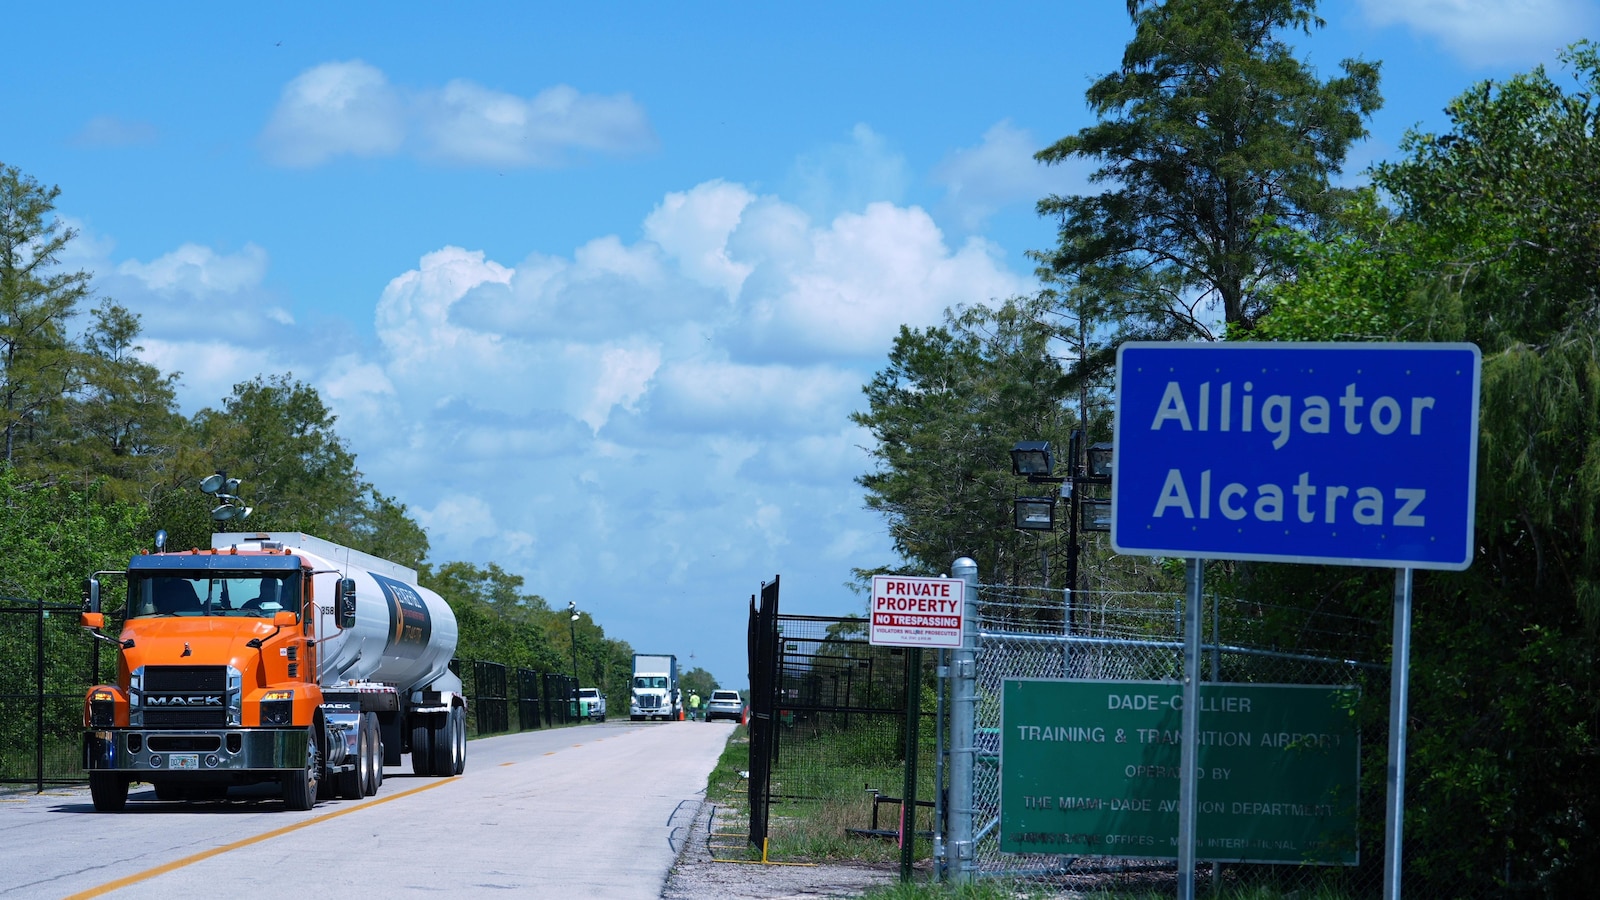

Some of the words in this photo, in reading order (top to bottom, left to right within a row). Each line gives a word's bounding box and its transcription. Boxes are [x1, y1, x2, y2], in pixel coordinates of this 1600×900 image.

[1150, 381, 1436, 450] Alligator
[1152, 469, 1427, 527] Alcatraz
[886, 581, 950, 597] PRIVATE
[877, 597, 958, 613] PROPERTY
[876, 615, 890, 624] NO
[892, 615, 958, 627] TRESPASSING
[146, 695, 222, 706] MACK
[1108, 694, 1251, 712] DADE-CLLIER
[1017, 725, 1105, 743] TRAINING
[1114, 728, 1127, 744] &
[1136, 728, 1251, 746] TRANITION
[1212, 768, 1231, 780] BY
[1024, 796, 1051, 810] THE
[1059, 797, 1151, 812] MIAMI-DADE
[1158, 799, 1225, 814] AVIION
[1232, 802, 1335, 817] DEPARTMENT
[1105, 834, 1155, 846] OFFICES
